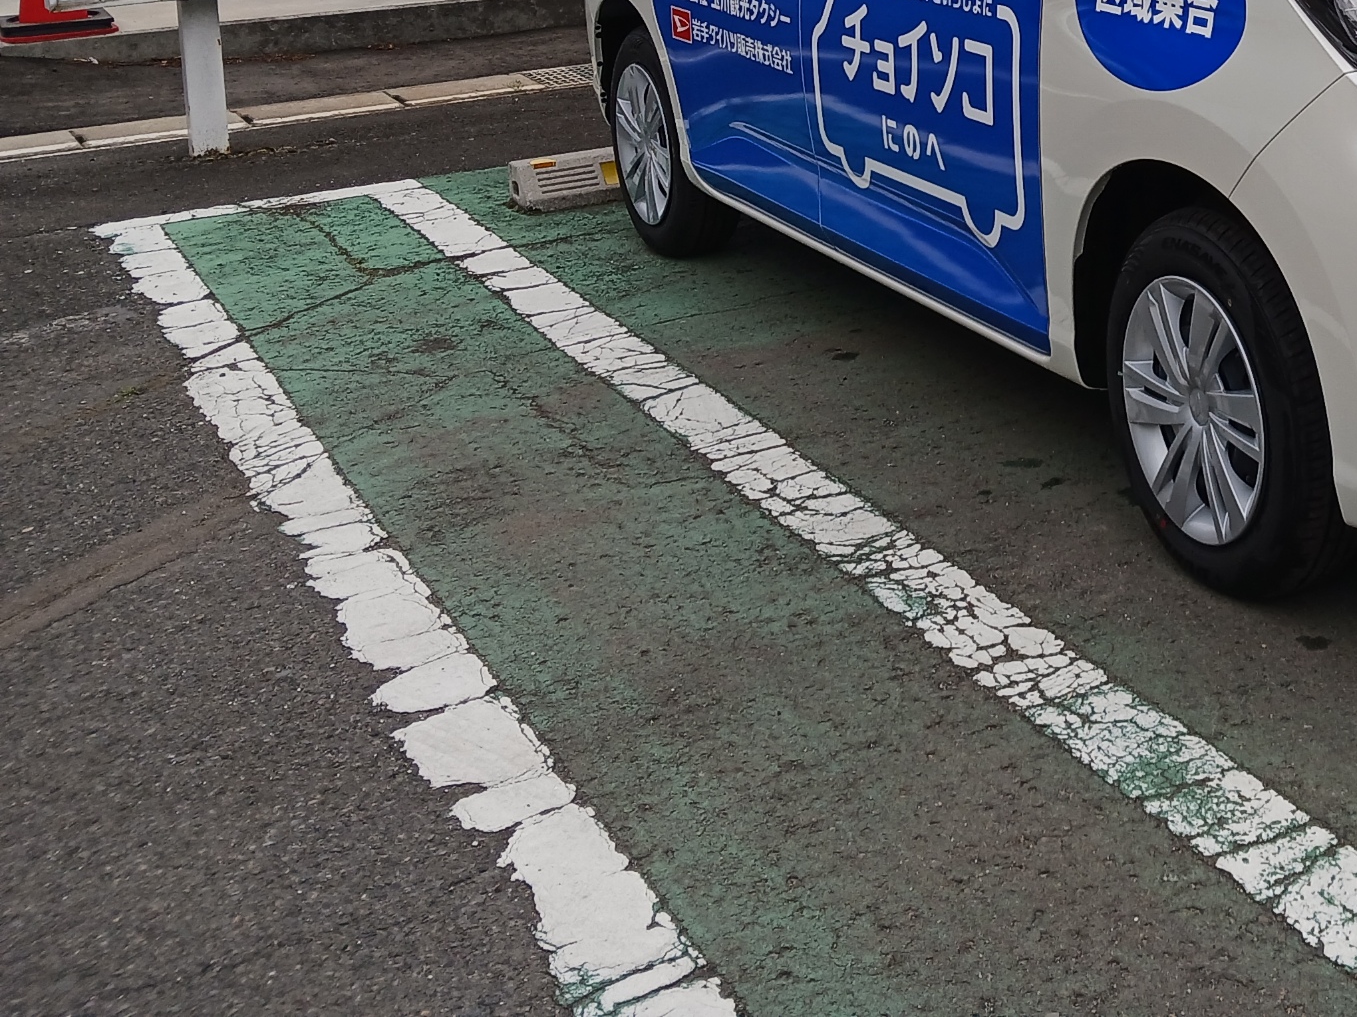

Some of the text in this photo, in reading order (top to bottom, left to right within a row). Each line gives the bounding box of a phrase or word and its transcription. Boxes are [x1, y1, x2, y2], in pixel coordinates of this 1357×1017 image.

[692, 18, 793, 74] 岩手ダイハツ販売株式会社
[841, 4, 994, 126] チョイソコ
[881, 115, 945, 171] にのへ
